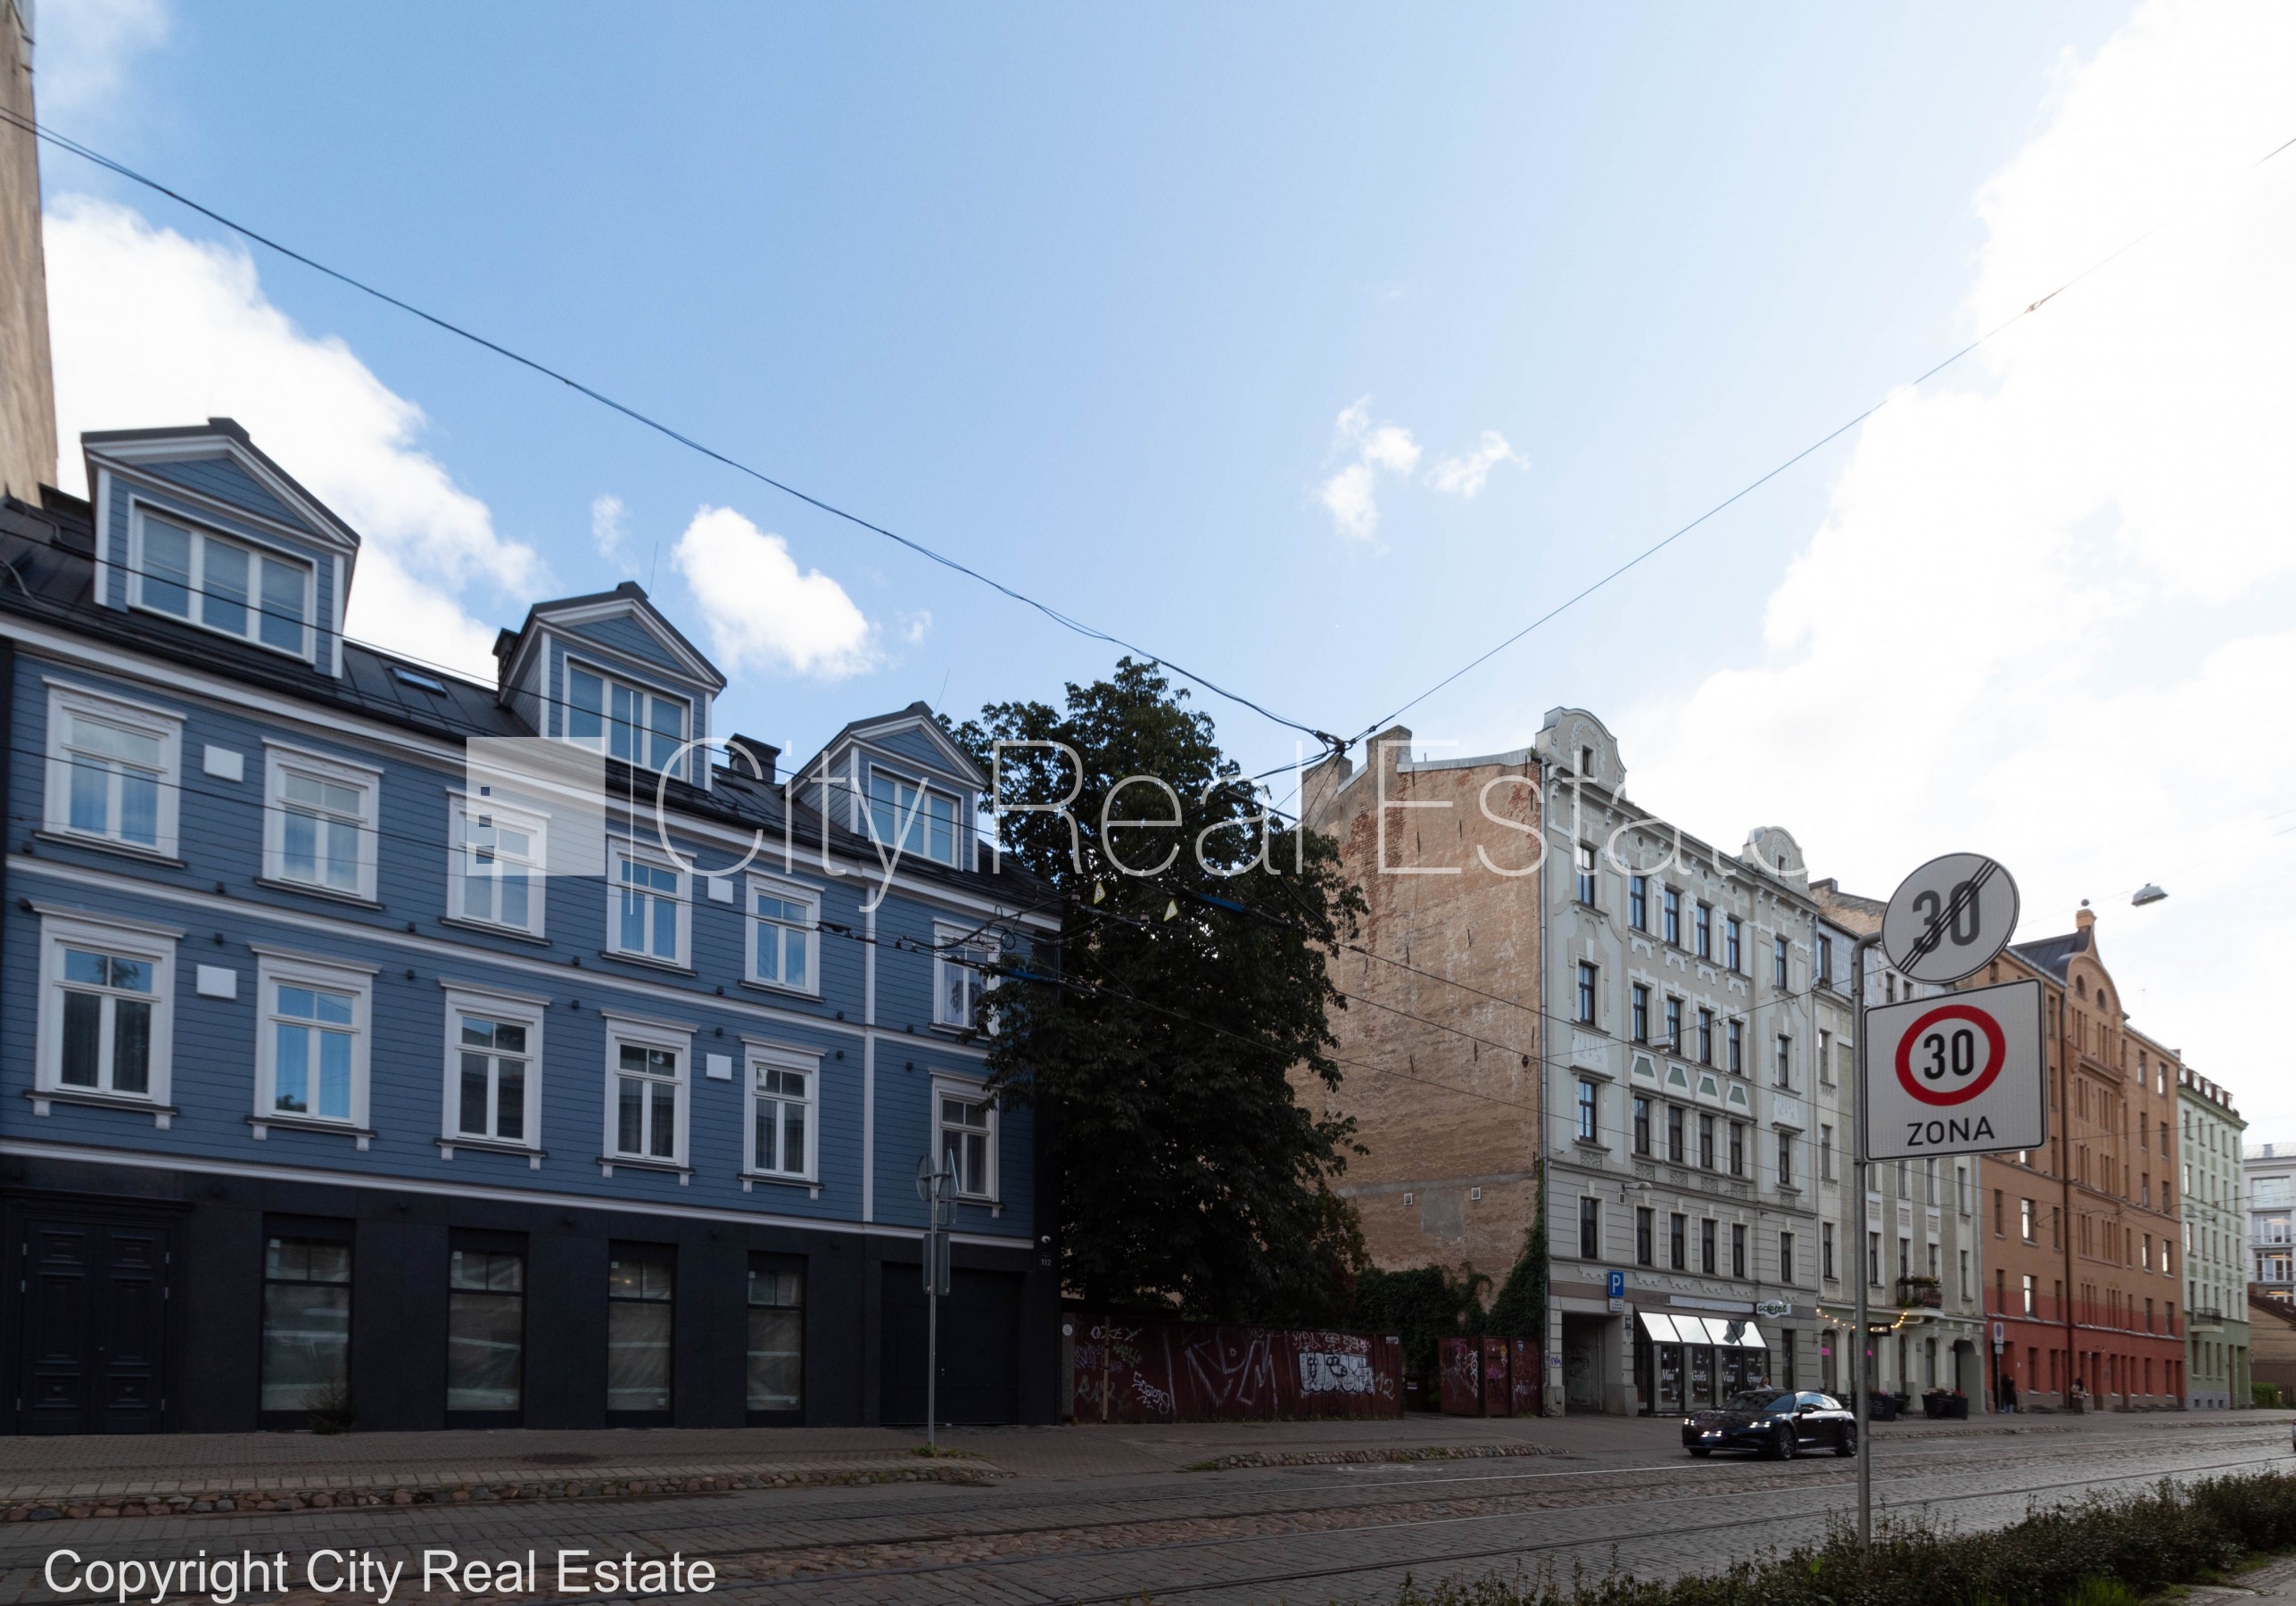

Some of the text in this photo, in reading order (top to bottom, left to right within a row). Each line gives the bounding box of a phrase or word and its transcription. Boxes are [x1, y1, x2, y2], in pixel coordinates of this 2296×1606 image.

[1912, 880, 1980, 954] 30
[1923, 1029, 1975, 1080] 30
[1907, 1116, 1995, 1147] ZONA
[1041, 1258, 1052, 1267] 112
[1612, 1274, 1621, 1293] P
[1691, 1370, 1707, 1382] Golfs
